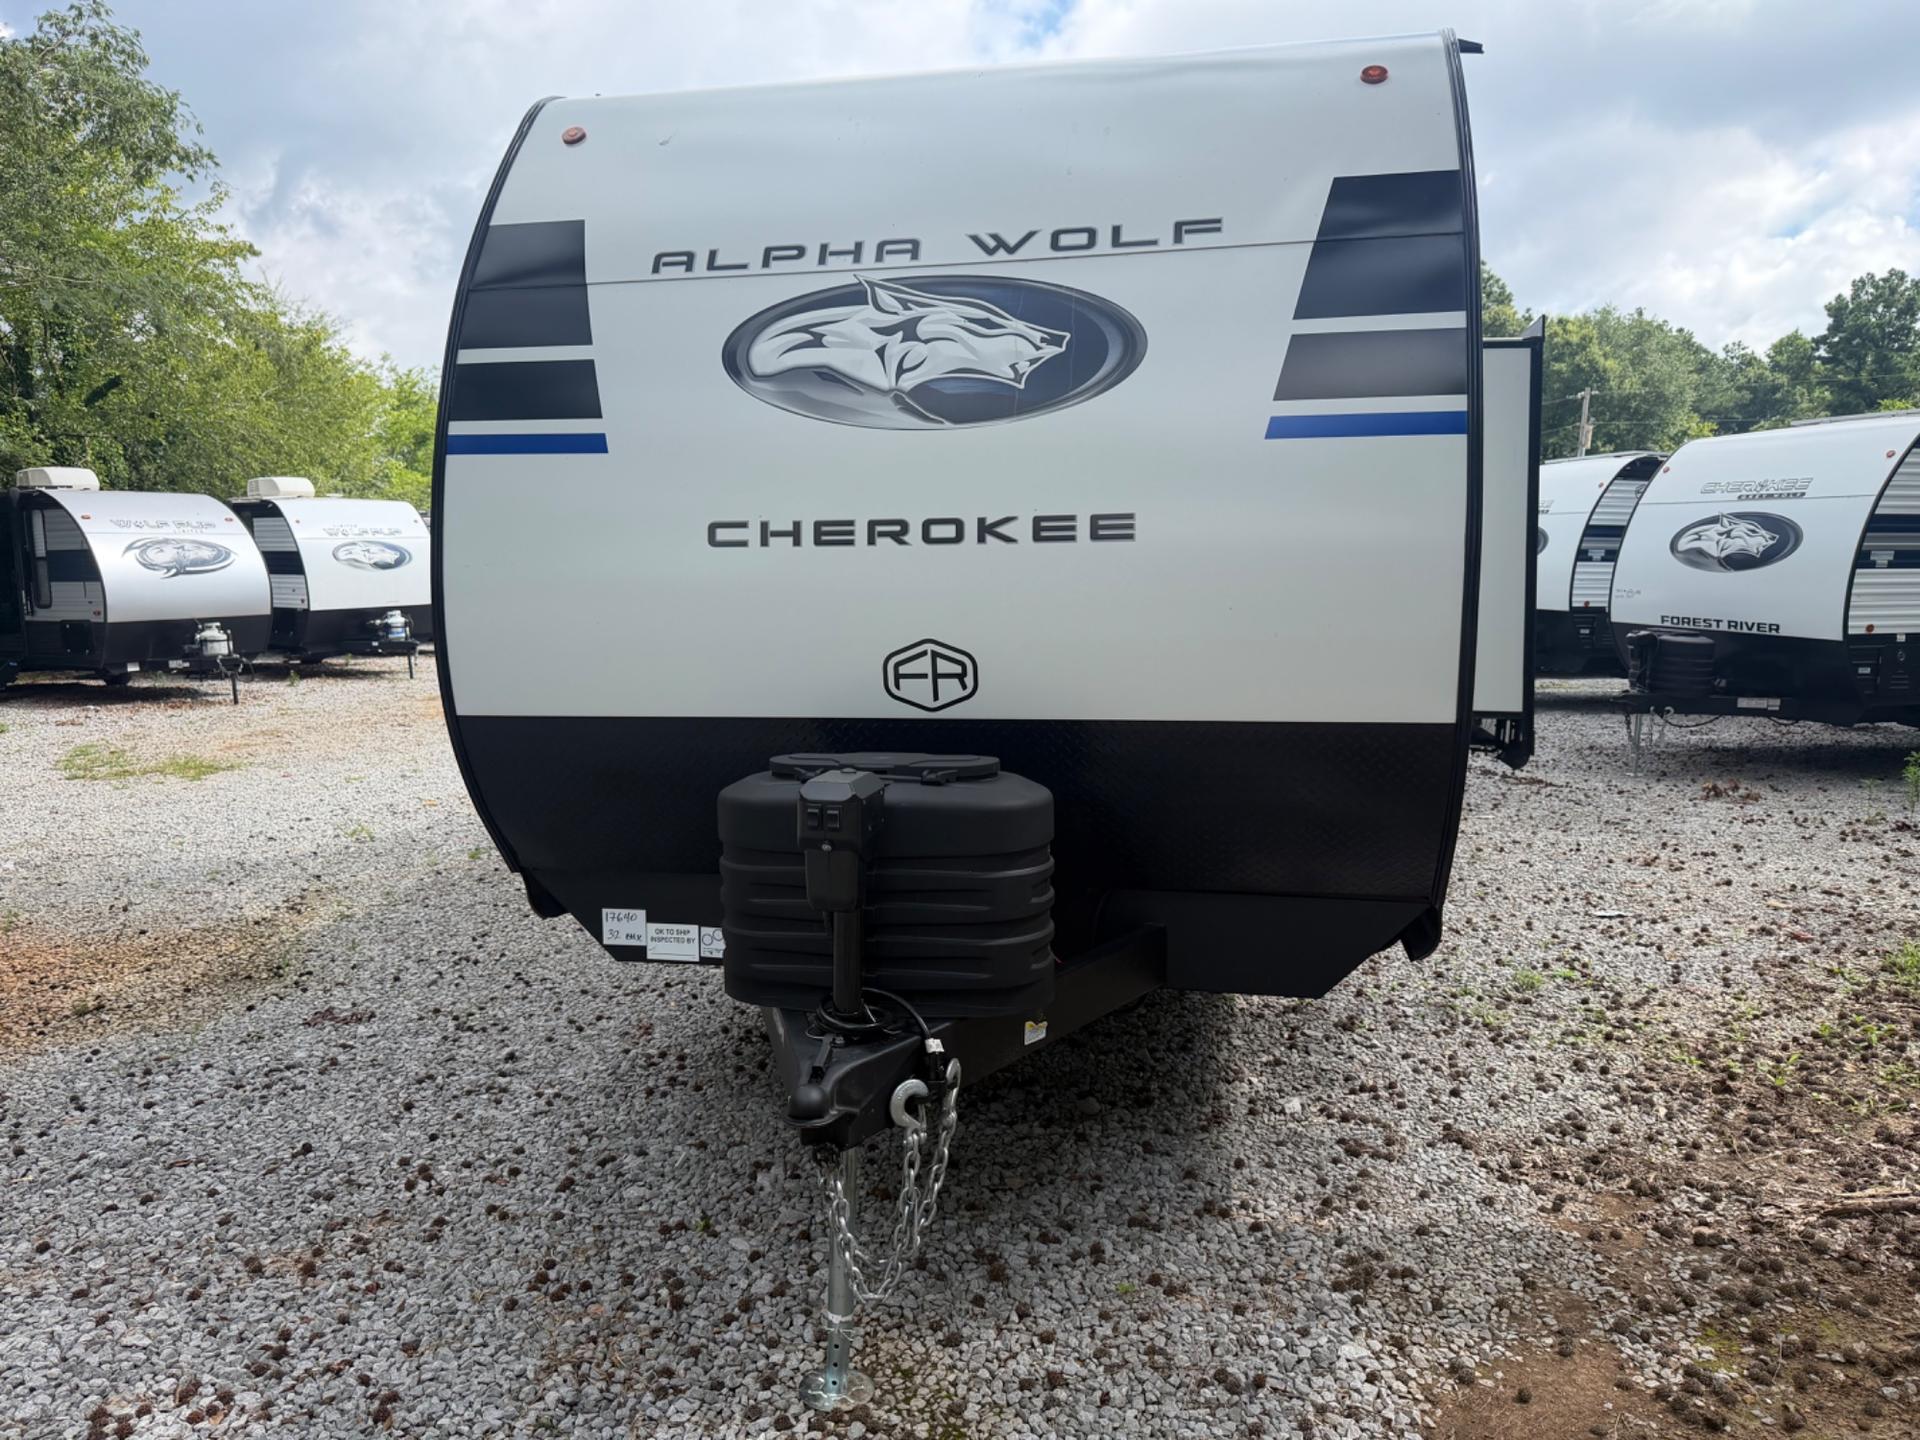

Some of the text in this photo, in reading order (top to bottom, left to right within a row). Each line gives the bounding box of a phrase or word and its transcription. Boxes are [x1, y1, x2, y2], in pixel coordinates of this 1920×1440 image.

[651, 217, 1224, 275] ALPHA WOLF
[1699, 477, 1814, 495] CHEROKEE
[707, 512, 1136, 548] CHEROKEE
[1660, 615, 1781, 634] FOREST RIVER
[893, 647, 968, 703] FR
[650, 935, 696, 945] INSPECTED BY
[666, 928, 674, 936] TO
